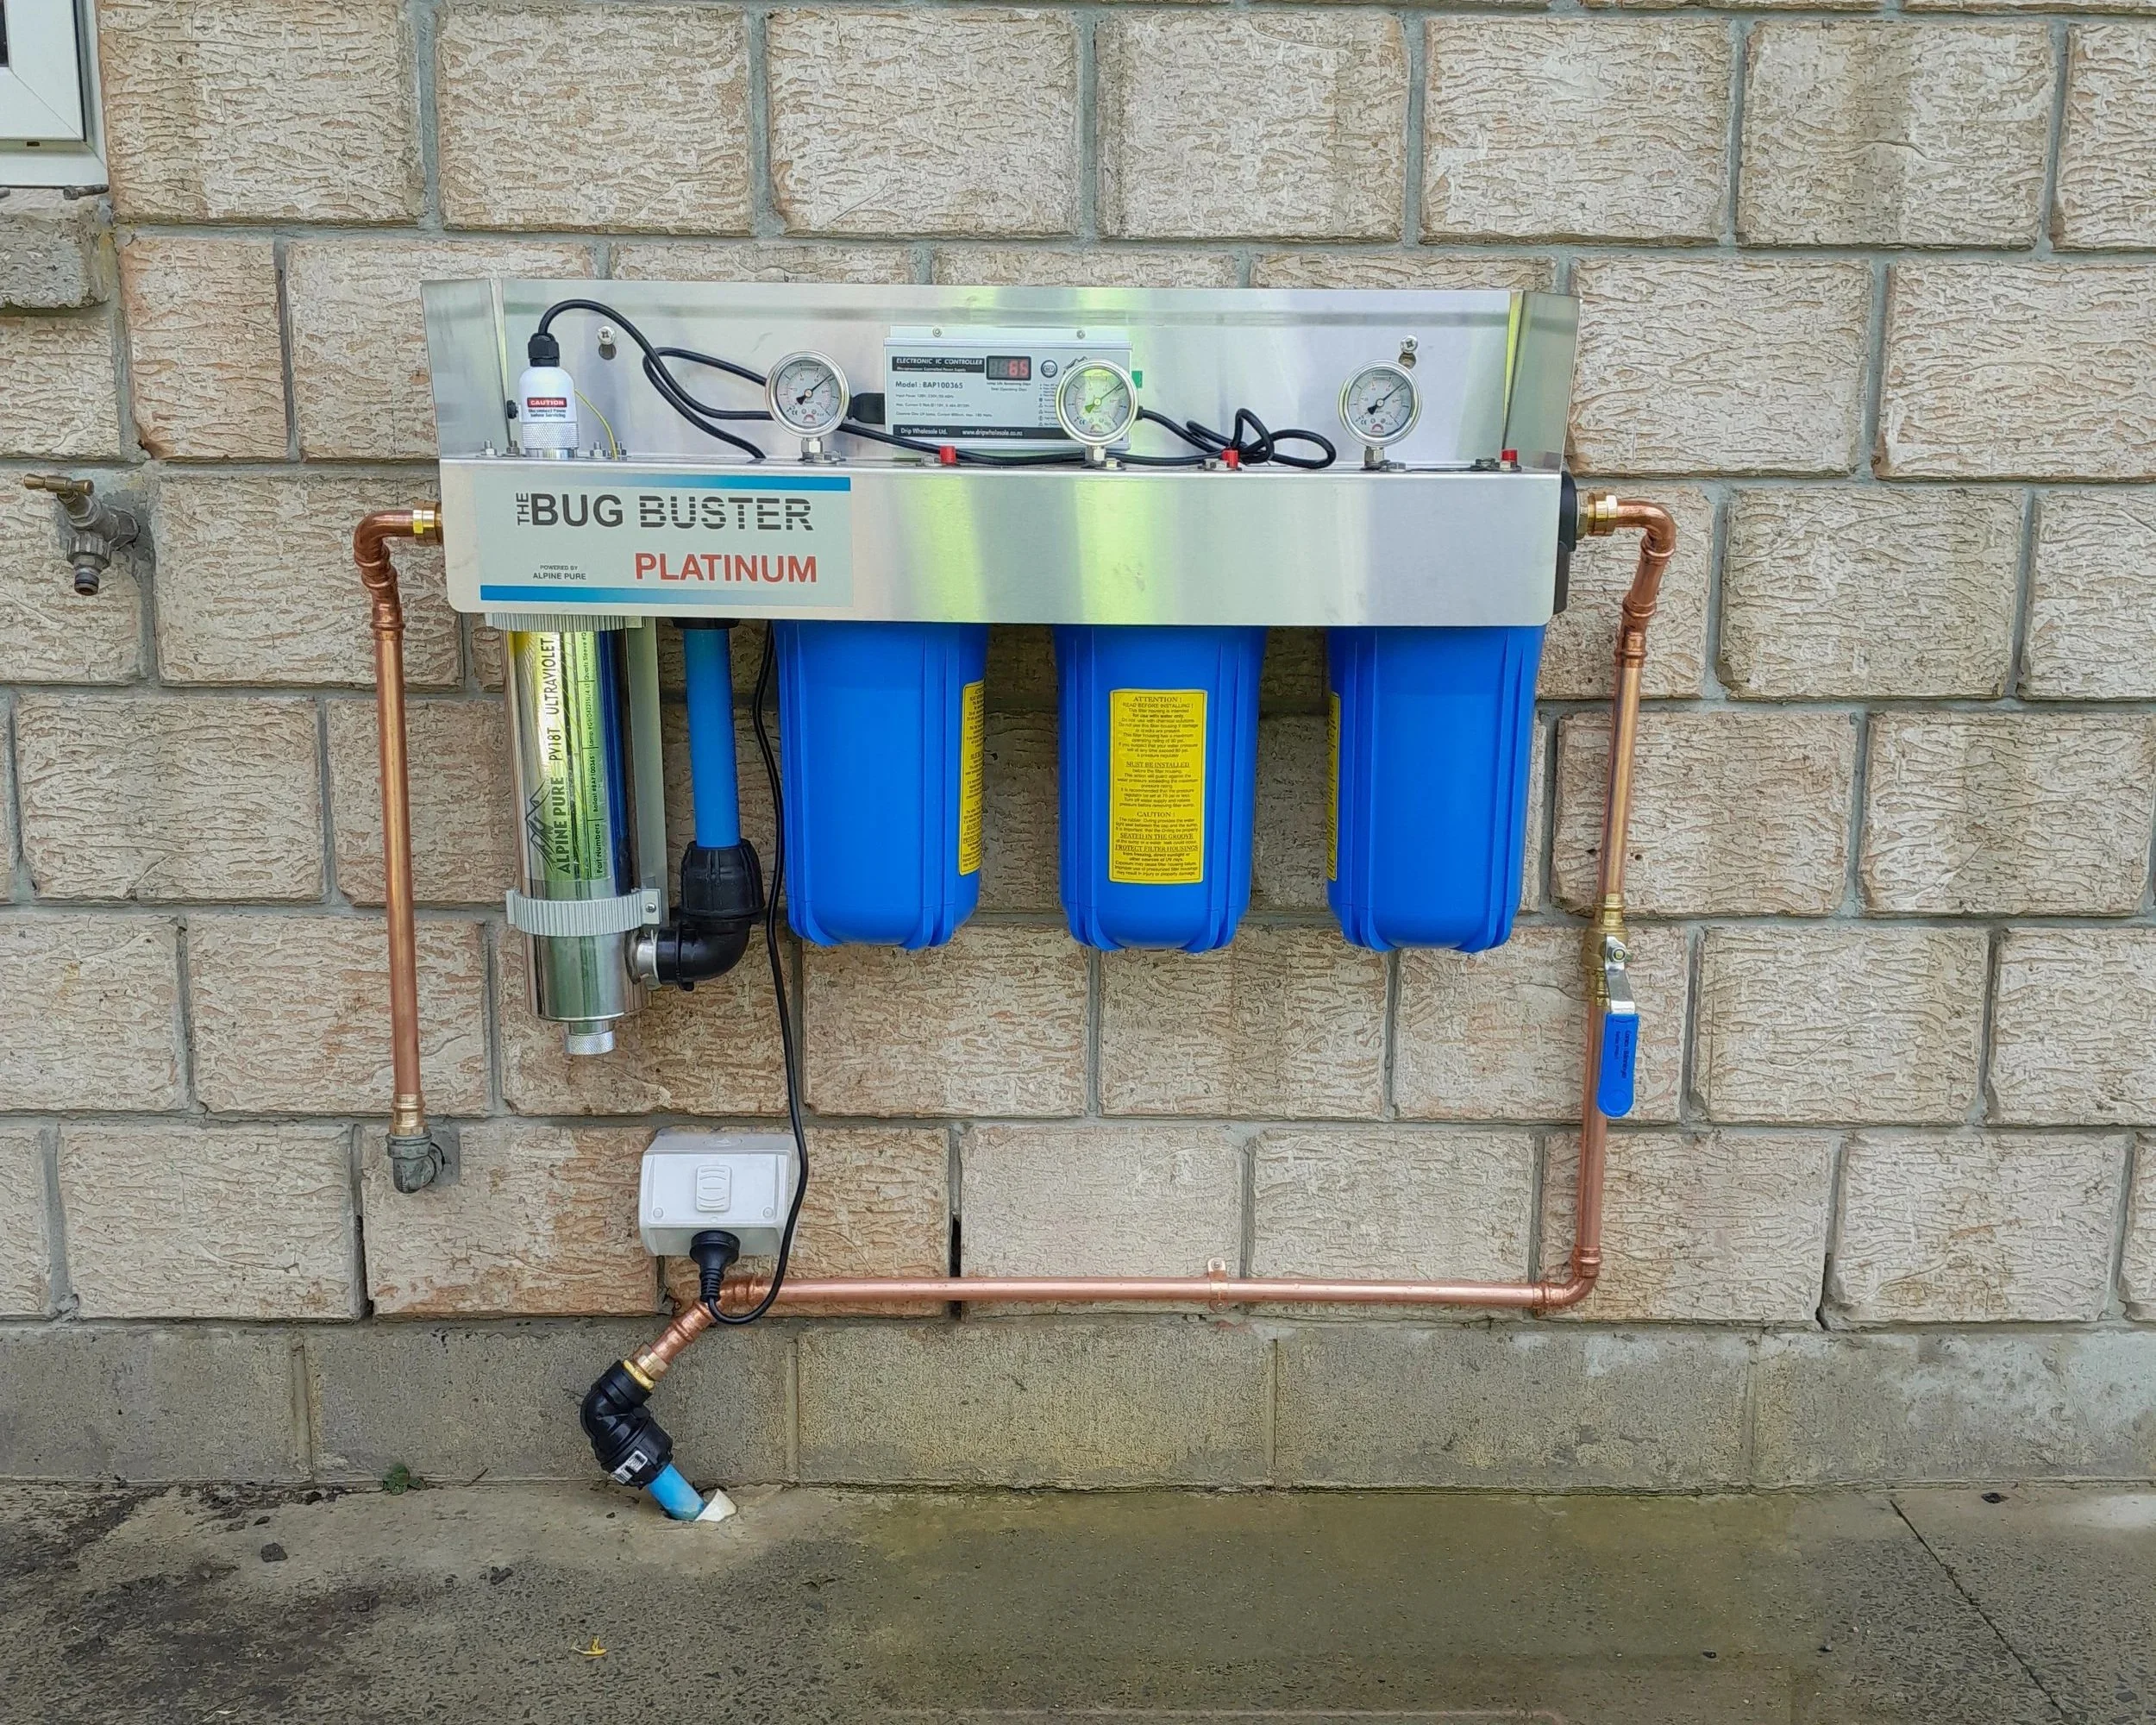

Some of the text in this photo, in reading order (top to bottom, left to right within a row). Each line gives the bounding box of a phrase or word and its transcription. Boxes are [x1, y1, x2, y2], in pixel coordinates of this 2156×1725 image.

[516, 493, 814, 530] THE BUG BUSTER
[635, 553, 817, 583] PLATINUM
[540, 637, 560, 716] ULTRAVIOLET
[548, 726, 561, 761] PV18T
[552, 777, 571, 874] ALPINE PURE
